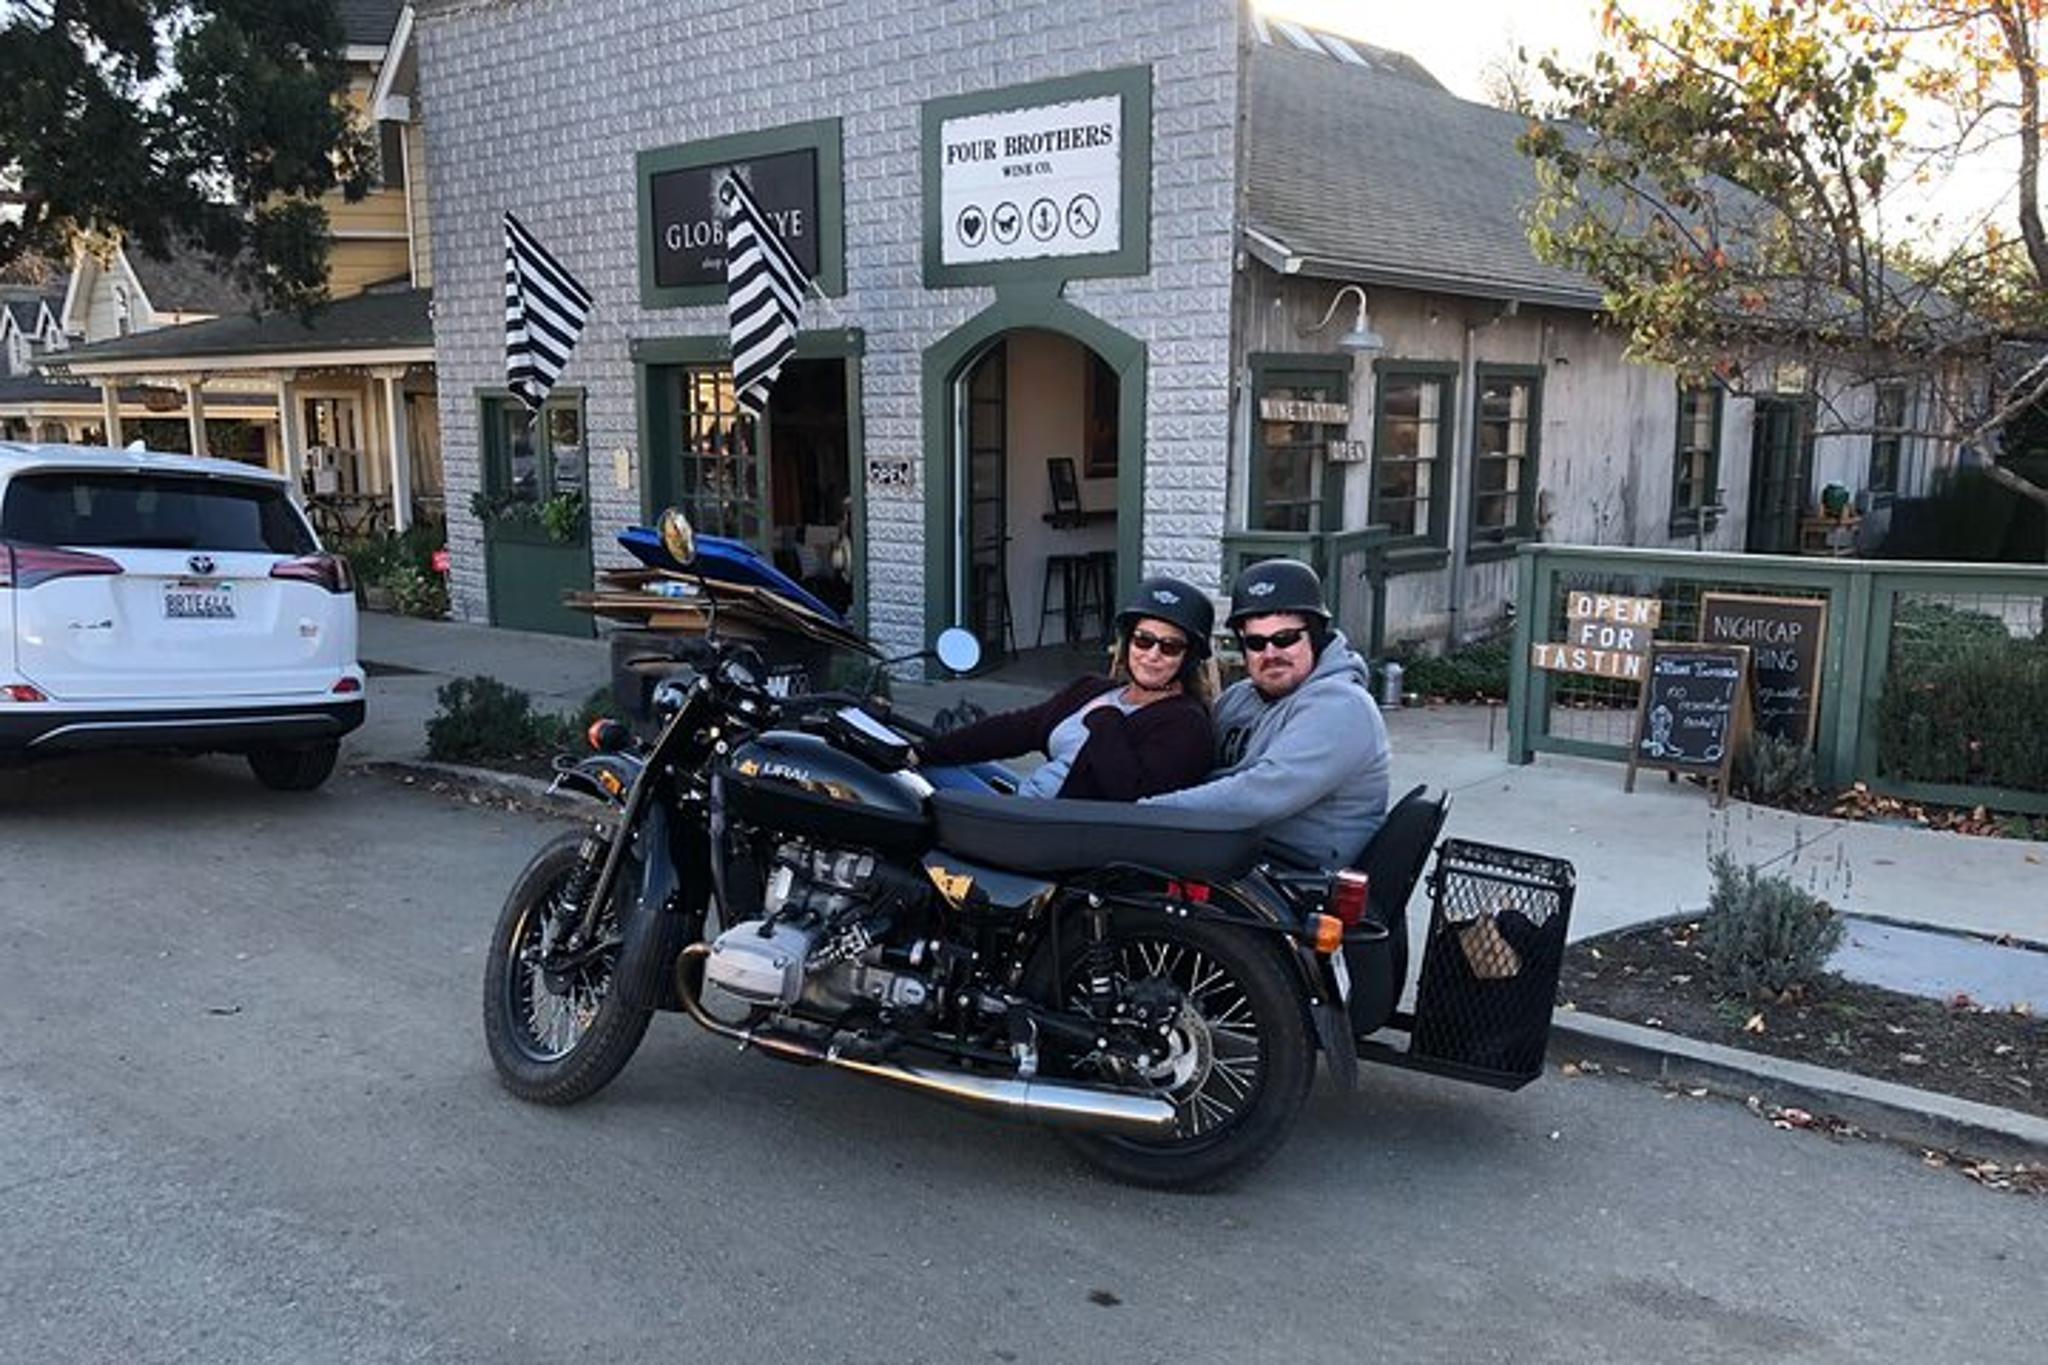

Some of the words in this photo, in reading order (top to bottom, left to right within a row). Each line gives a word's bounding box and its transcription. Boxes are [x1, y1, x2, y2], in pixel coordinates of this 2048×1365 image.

[947, 139, 997, 165] FOUR
[1004, 123, 1112, 158] BROTHERS
[1003, 163, 1033, 177] WINE
[666, 220, 728, 250] GLOB
[767, 210, 803, 238] YE
[1578, 596, 1648, 624] OPEN
[1581, 624, 1634, 650] FOR
[1714, 615, 1802, 643] NIGHTCAP
[1536, 644, 1640, 677] TASTIN
[1754, 647, 1799, 672] HING
